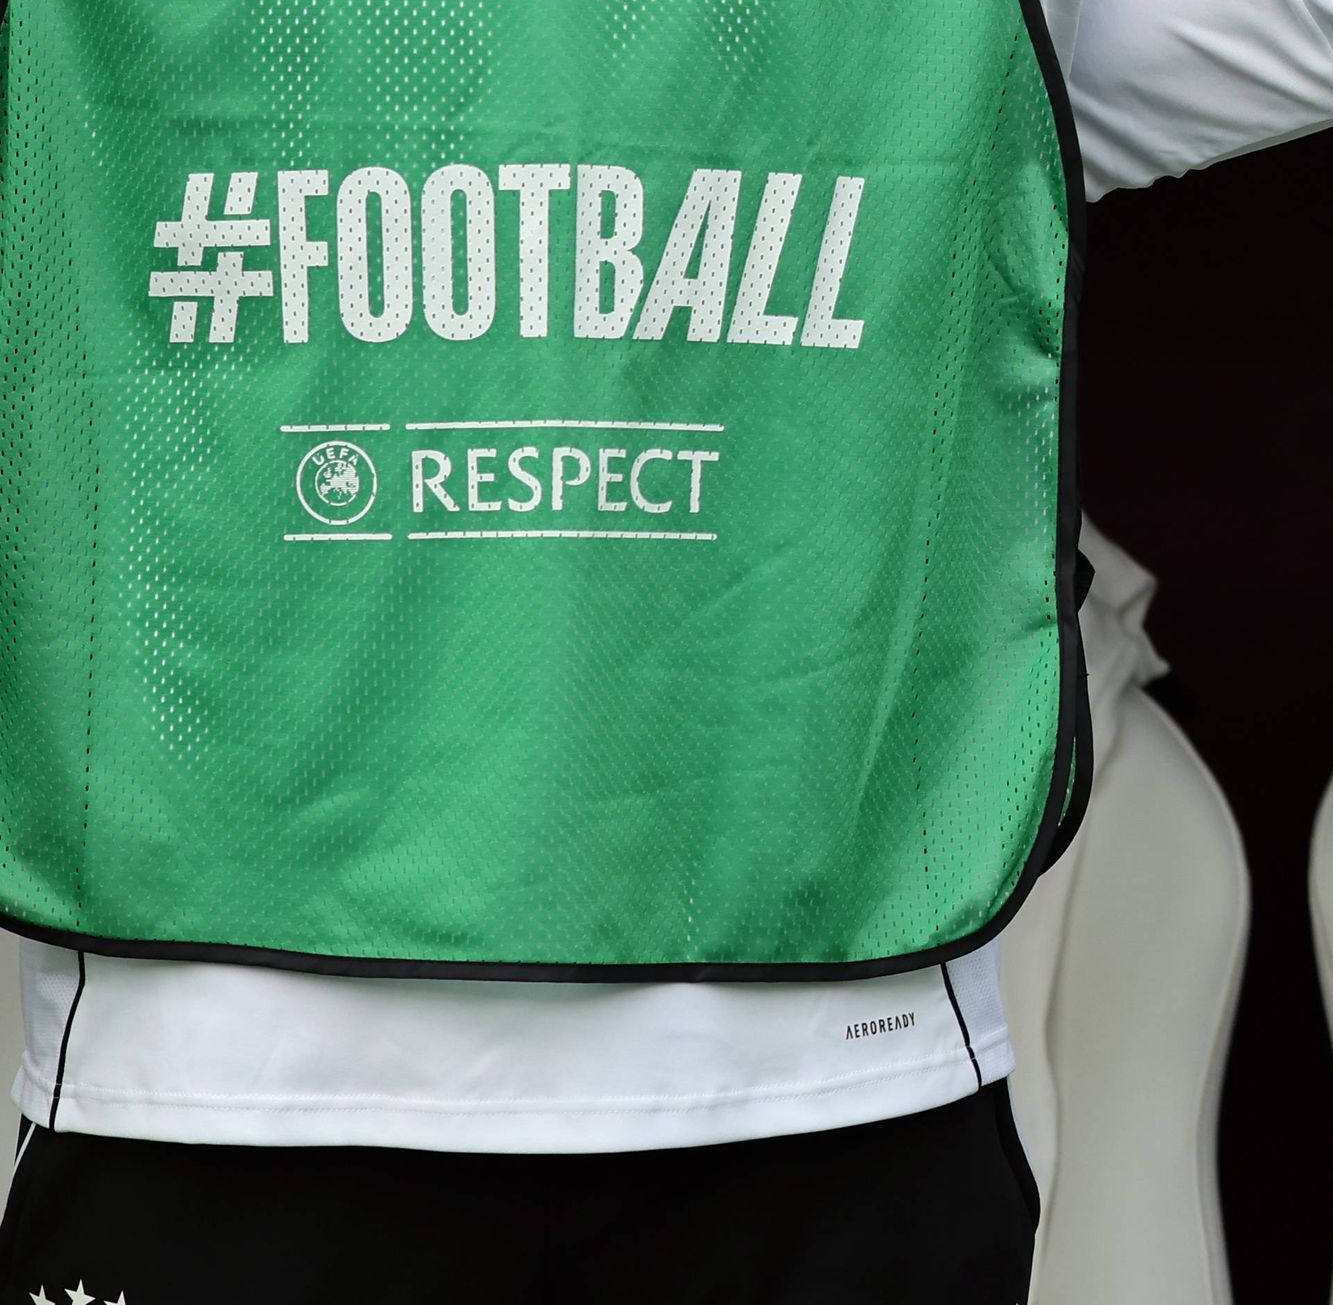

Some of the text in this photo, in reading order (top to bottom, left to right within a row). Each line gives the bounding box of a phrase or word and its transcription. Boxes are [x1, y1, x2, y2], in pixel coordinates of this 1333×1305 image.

[148, 163, 866, 349] #FOOTBALL
[311, 447, 359, 465] UEFA
[410, 446, 721, 515] RESPECT
[845, 1011, 915, 1040] AEROREADY
